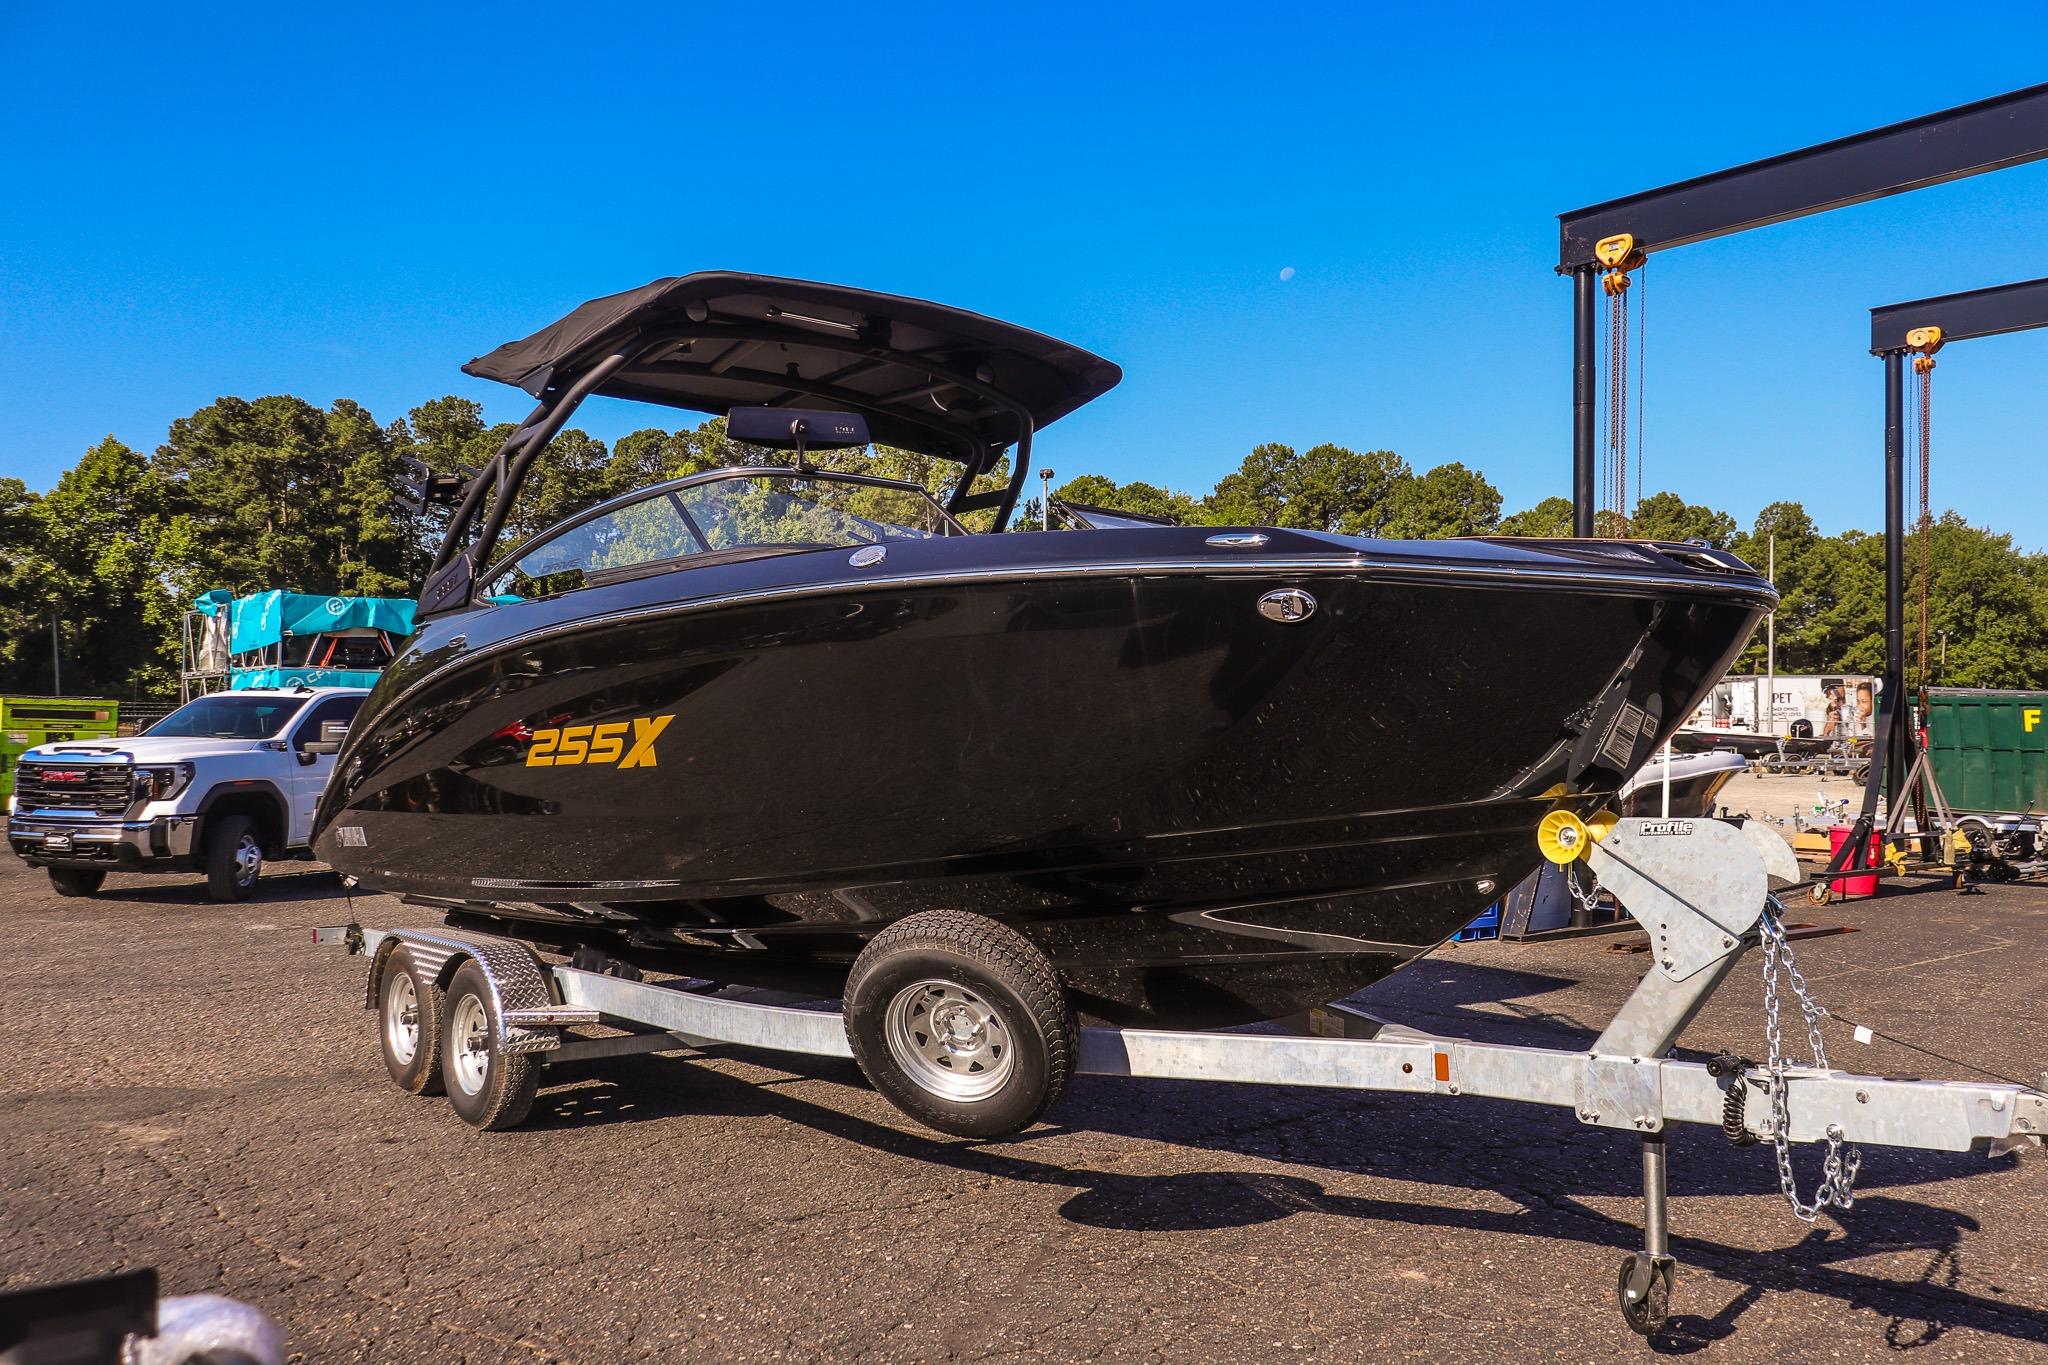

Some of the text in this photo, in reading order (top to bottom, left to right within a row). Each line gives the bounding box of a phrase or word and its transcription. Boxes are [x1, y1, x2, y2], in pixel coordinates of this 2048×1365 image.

[1772, 692, 1792, 704] PET
[2023, 709, 2041, 732] F
[525, 714, 677, 769] 255X
[41, 769, 87, 783] GMC
[1640, 820, 1693, 833] Profile
